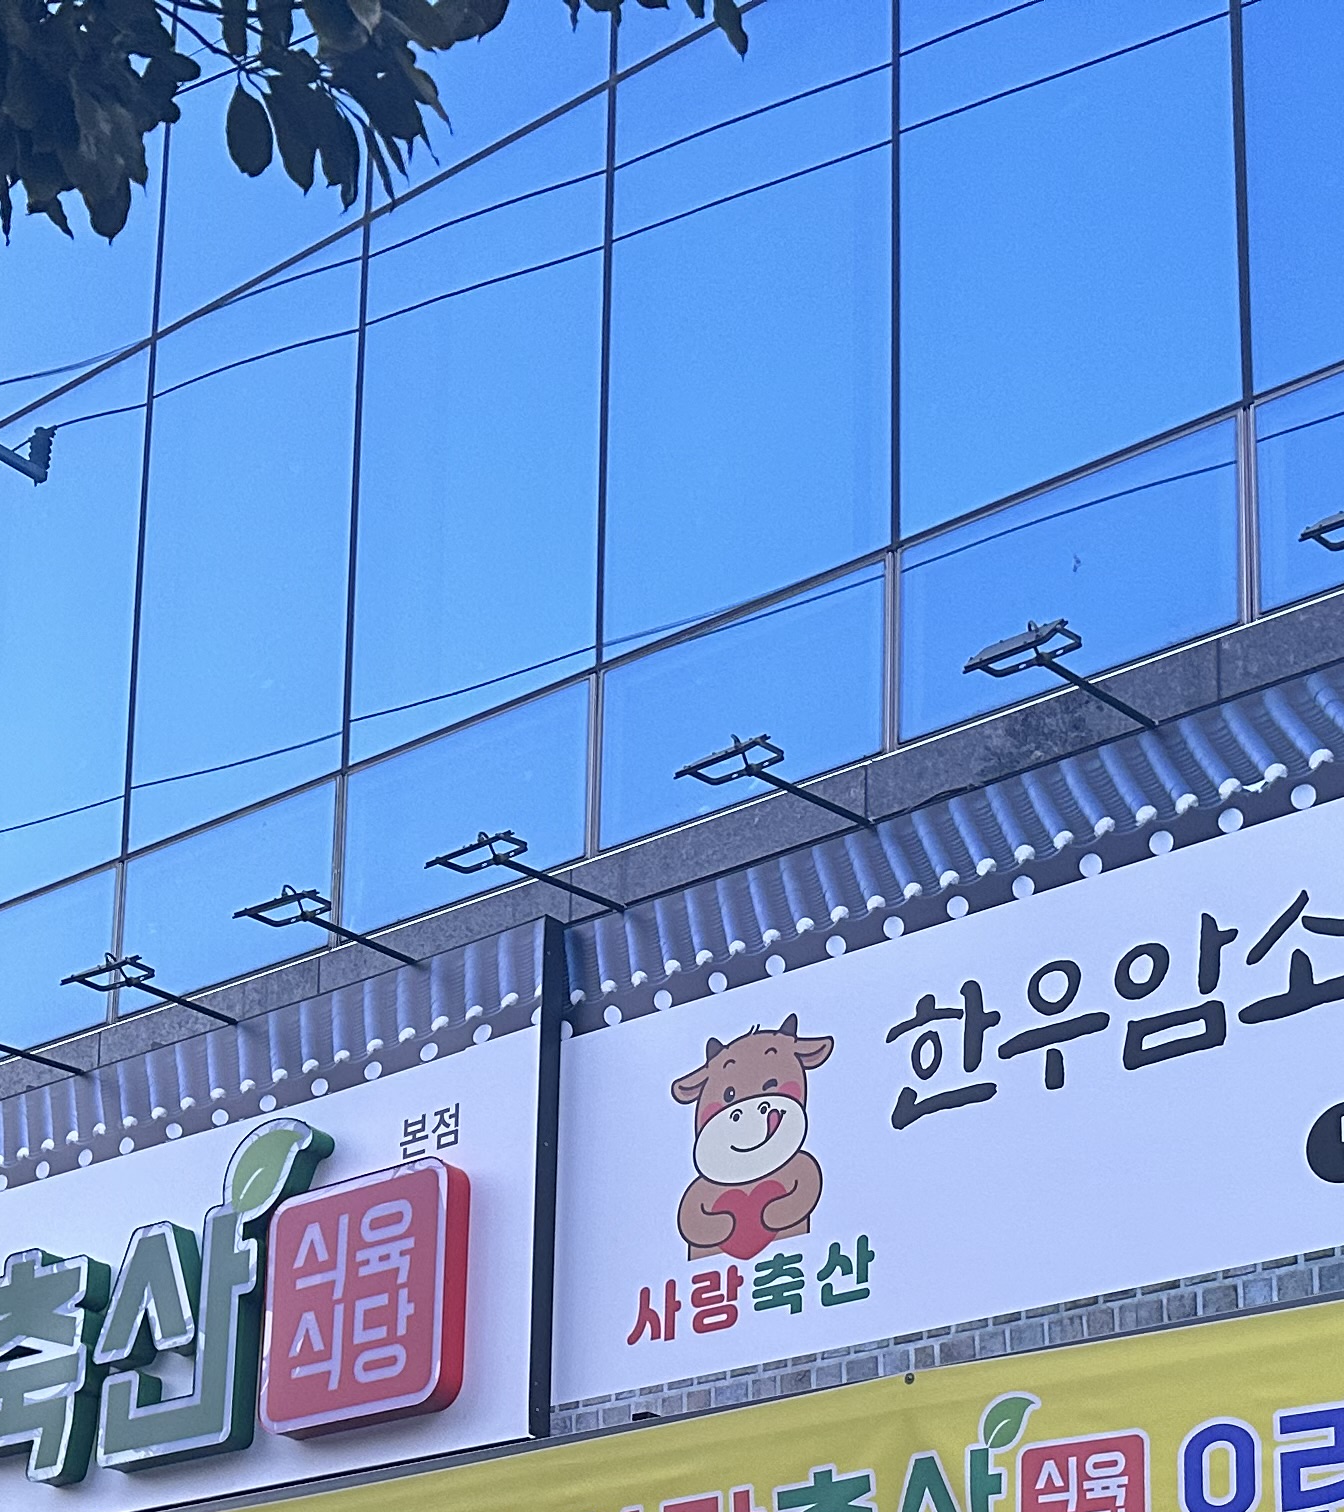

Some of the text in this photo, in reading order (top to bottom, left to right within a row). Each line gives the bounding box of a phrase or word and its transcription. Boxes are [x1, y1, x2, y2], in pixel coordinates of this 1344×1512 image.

[400, 1103, 462, 1160] 본점
[291, 1199, 416, 1300] 식육
[626, 1234, 874, 1347] 사랑축산
[288, 1292, 415, 1385] 식당
[1033, 1452, 1130, 1507] 식육
